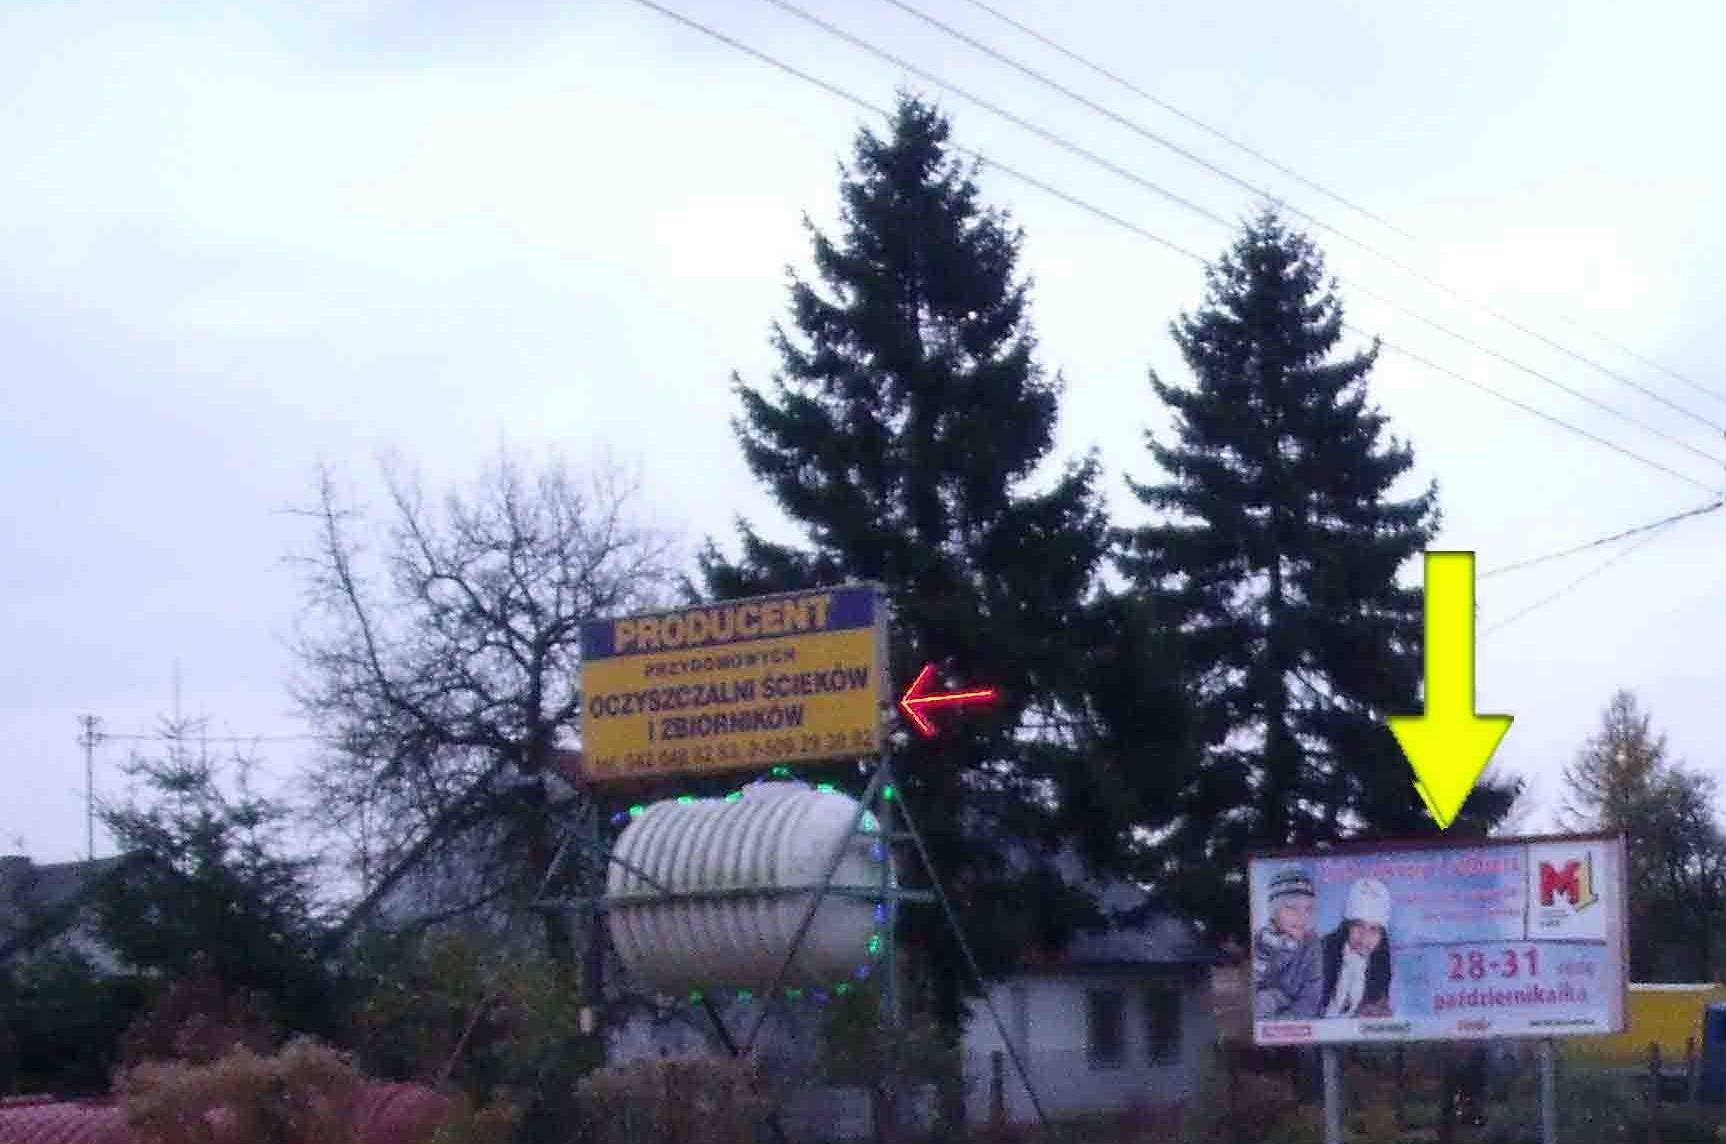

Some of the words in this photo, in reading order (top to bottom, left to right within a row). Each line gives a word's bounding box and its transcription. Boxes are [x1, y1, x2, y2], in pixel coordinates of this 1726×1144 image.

[615, 594, 830, 652] PRODUCENT
[590, 681, 756, 719] OCZYSZCZALNI
[648, 721, 655, 742] I
[1447, 947, 1540, 982] 28-31
